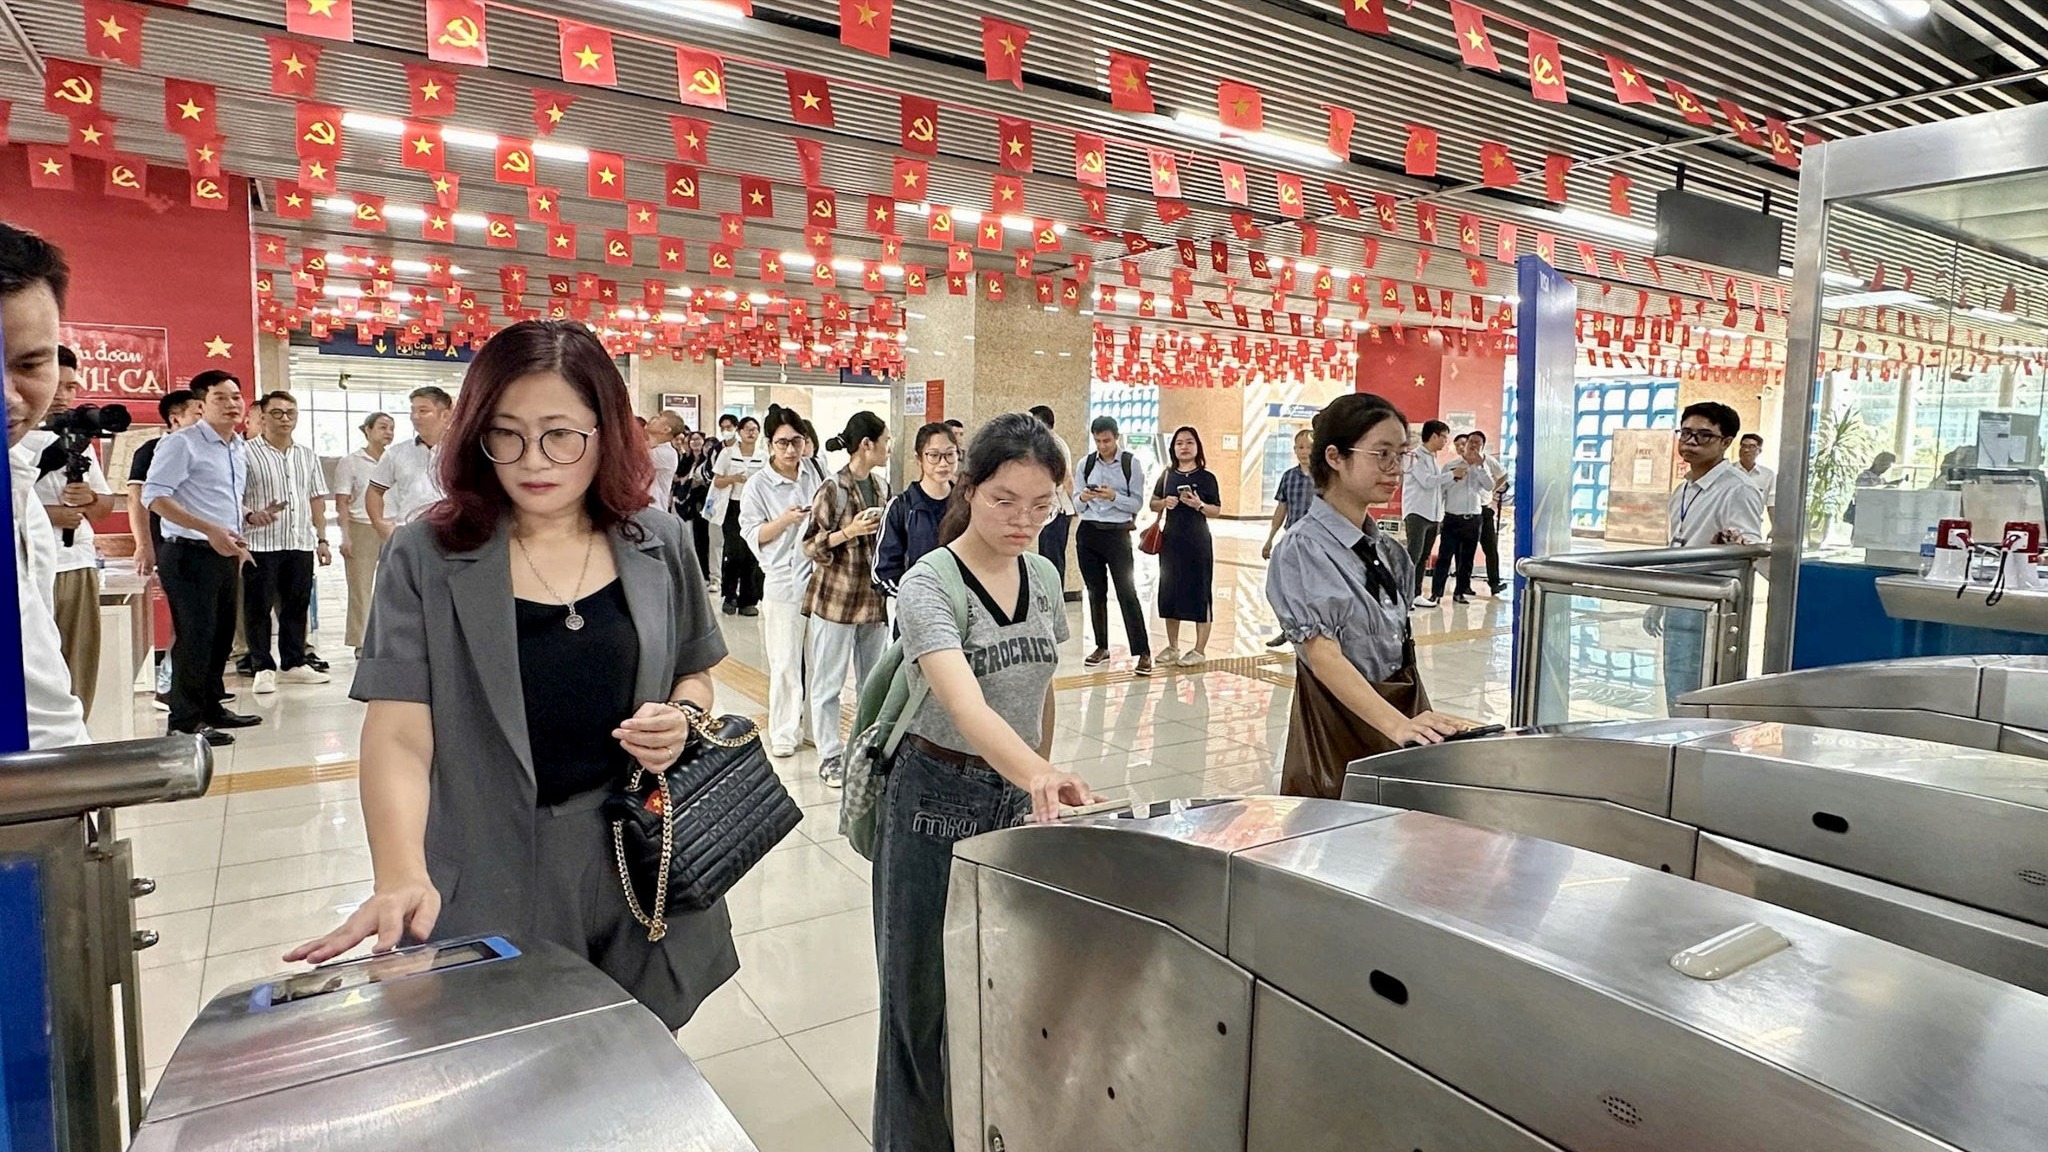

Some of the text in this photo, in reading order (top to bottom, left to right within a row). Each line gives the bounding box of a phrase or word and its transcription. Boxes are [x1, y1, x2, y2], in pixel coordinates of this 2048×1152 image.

[445, 344, 458, 357] A
[75, 366, 163, 394] NH-CA
[965, 637, 1059, 678] EROCRIC
